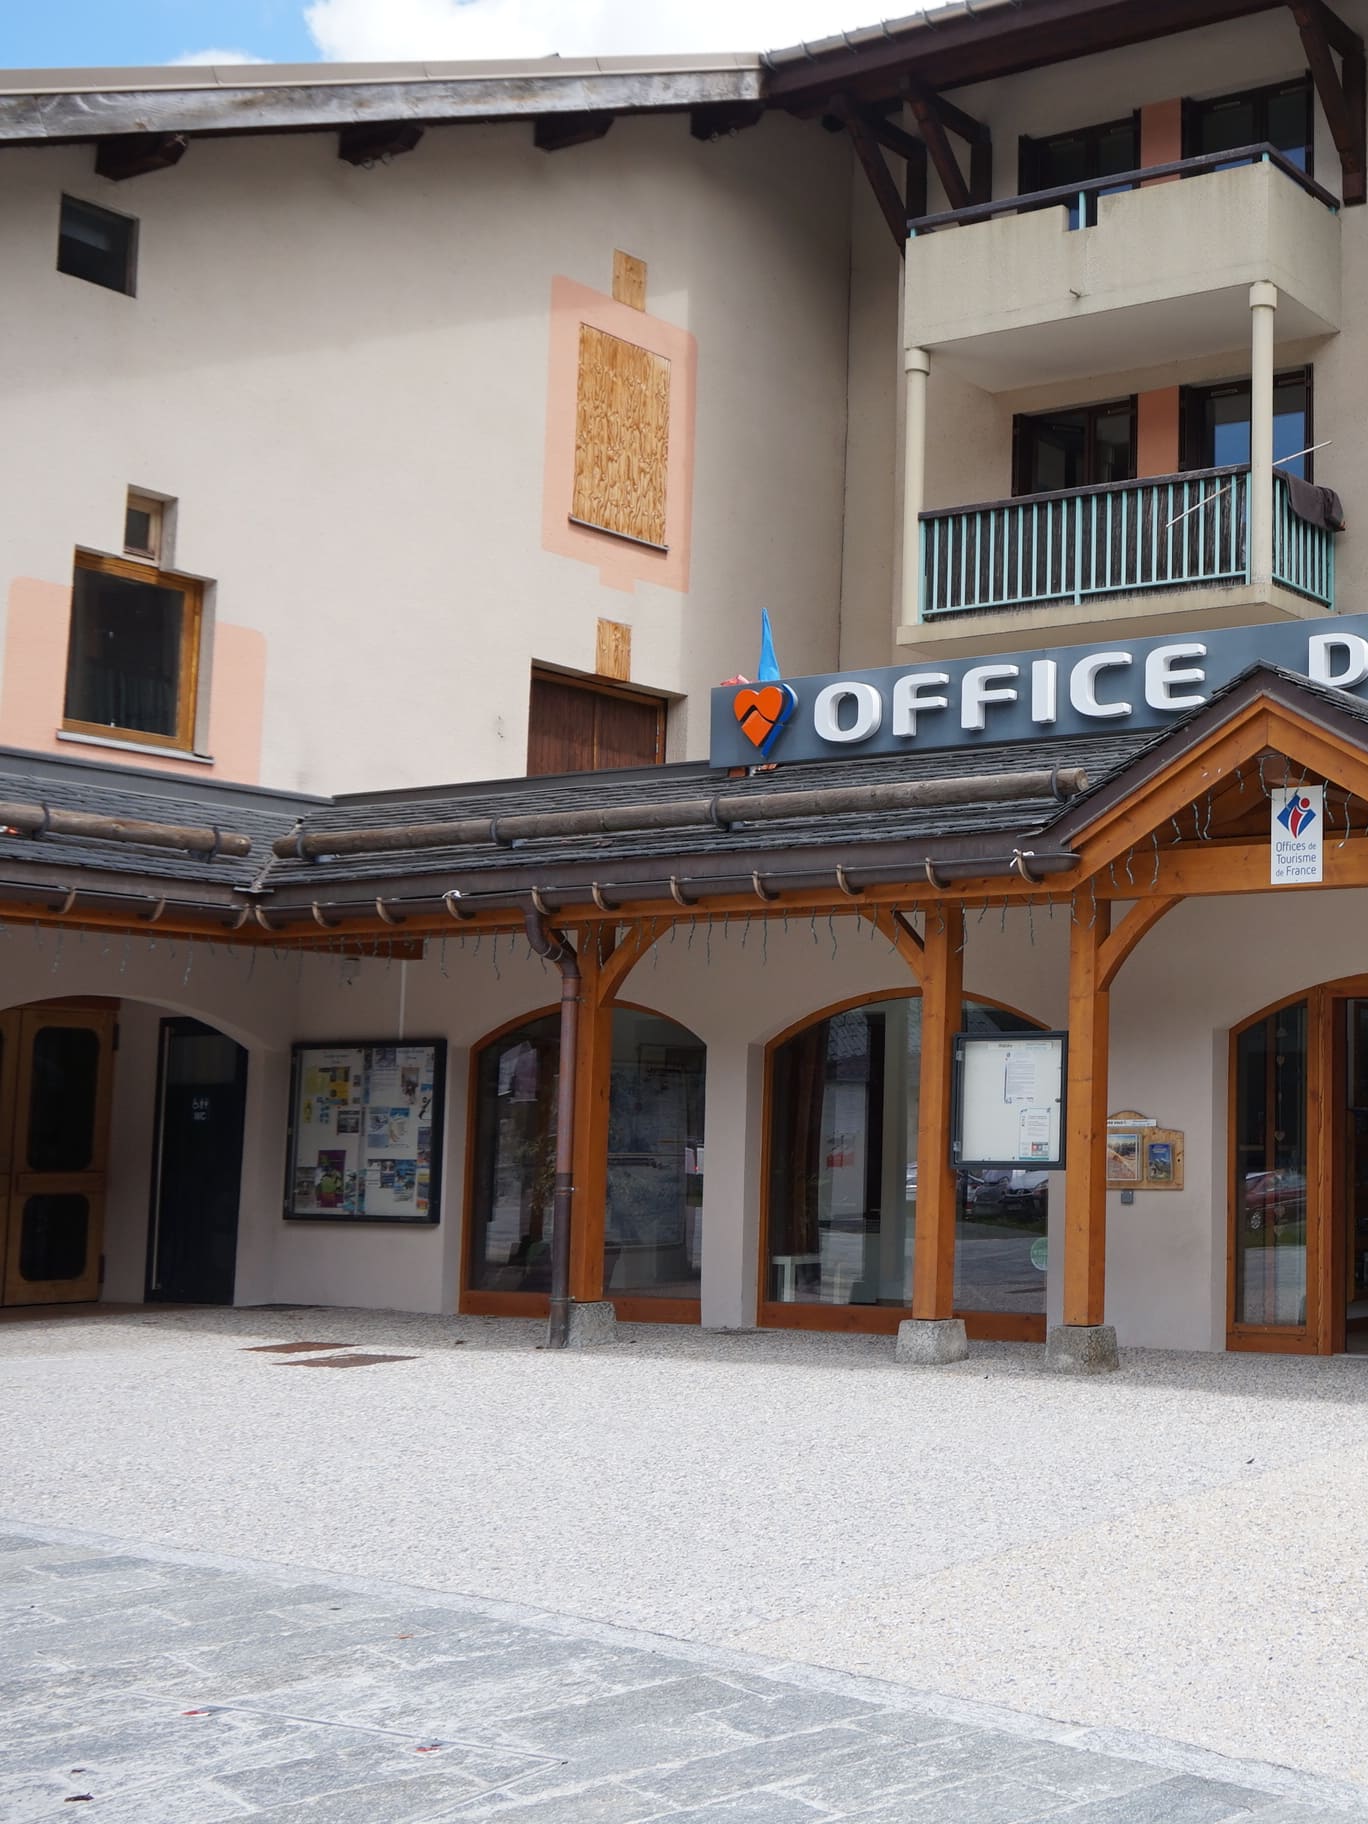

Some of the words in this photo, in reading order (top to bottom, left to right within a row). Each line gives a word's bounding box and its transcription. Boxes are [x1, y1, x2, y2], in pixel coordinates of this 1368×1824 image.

[814, 642, 1207, 744] OFFICE
[1276, 841, 1306, 852] Offices
[1307, 842, 1317, 850] de
[1276, 854, 1317, 865] Tourisme
[1275, 869, 1284, 877] de
[1286, 866, 1317, 876] France
